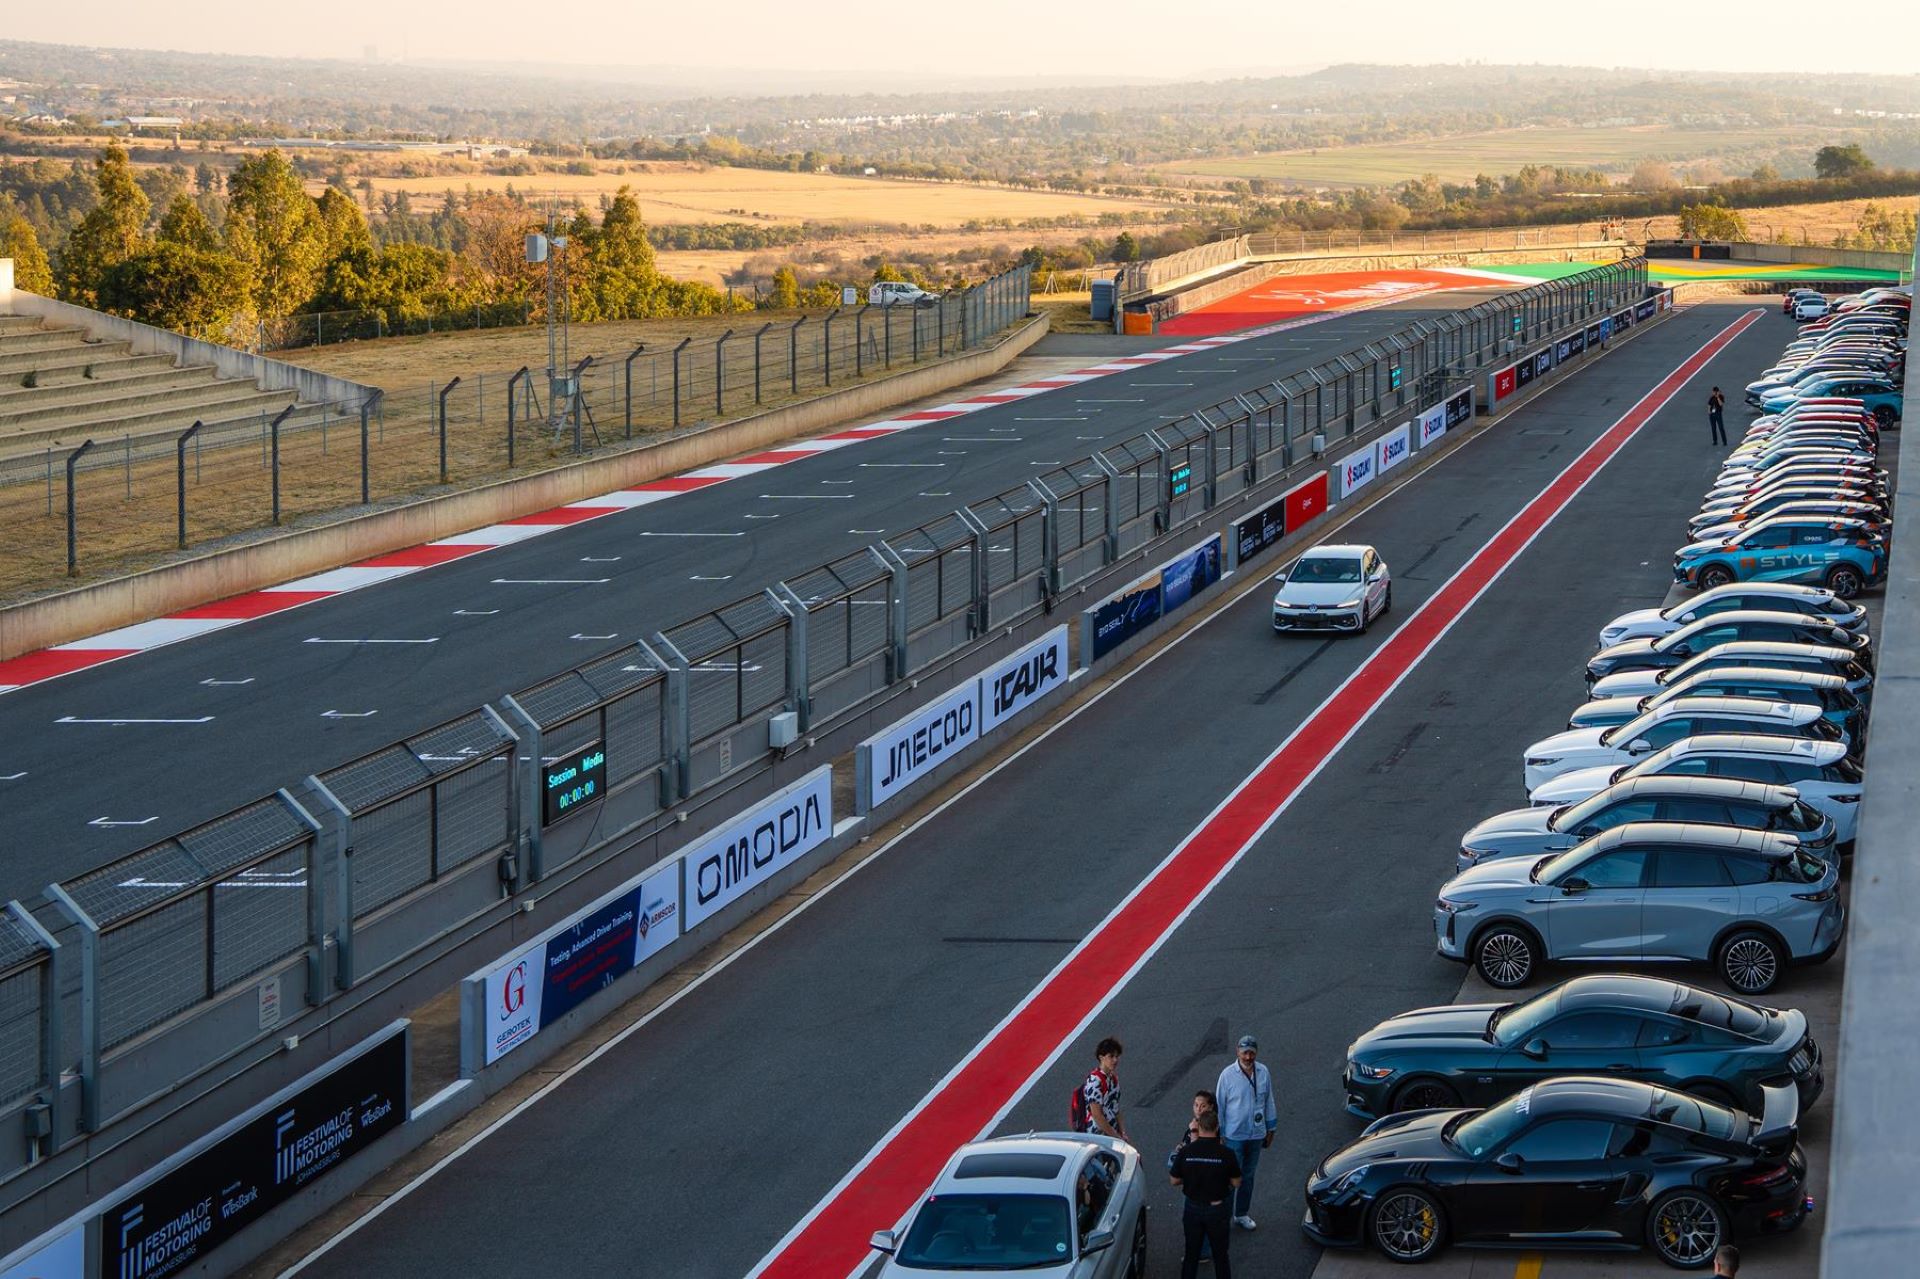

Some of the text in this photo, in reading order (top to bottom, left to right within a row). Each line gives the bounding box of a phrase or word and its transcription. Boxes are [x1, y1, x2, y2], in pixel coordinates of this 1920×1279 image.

[1428, 414, 1442, 435] SUZUKI
[1388, 437, 1405, 459] SUZUKI
[1352, 457, 1371, 482] SUZUKI
[1761, 552, 1839, 567] STYLE
[881, 700, 972, 788] JAECOO
[549, 752, 604, 789] Session Media
[560, 780, 594, 808] 00:00:00
[697, 793, 822, 906] OMODA
[572, 931, 596, 954] Advanced
[597, 922, 612, 938] Driver
[497, 1016, 531, 1044] GEROTEK
[296, 1124, 353, 1171] MOTORING
[145, 1216, 212, 1272] MOTORING
